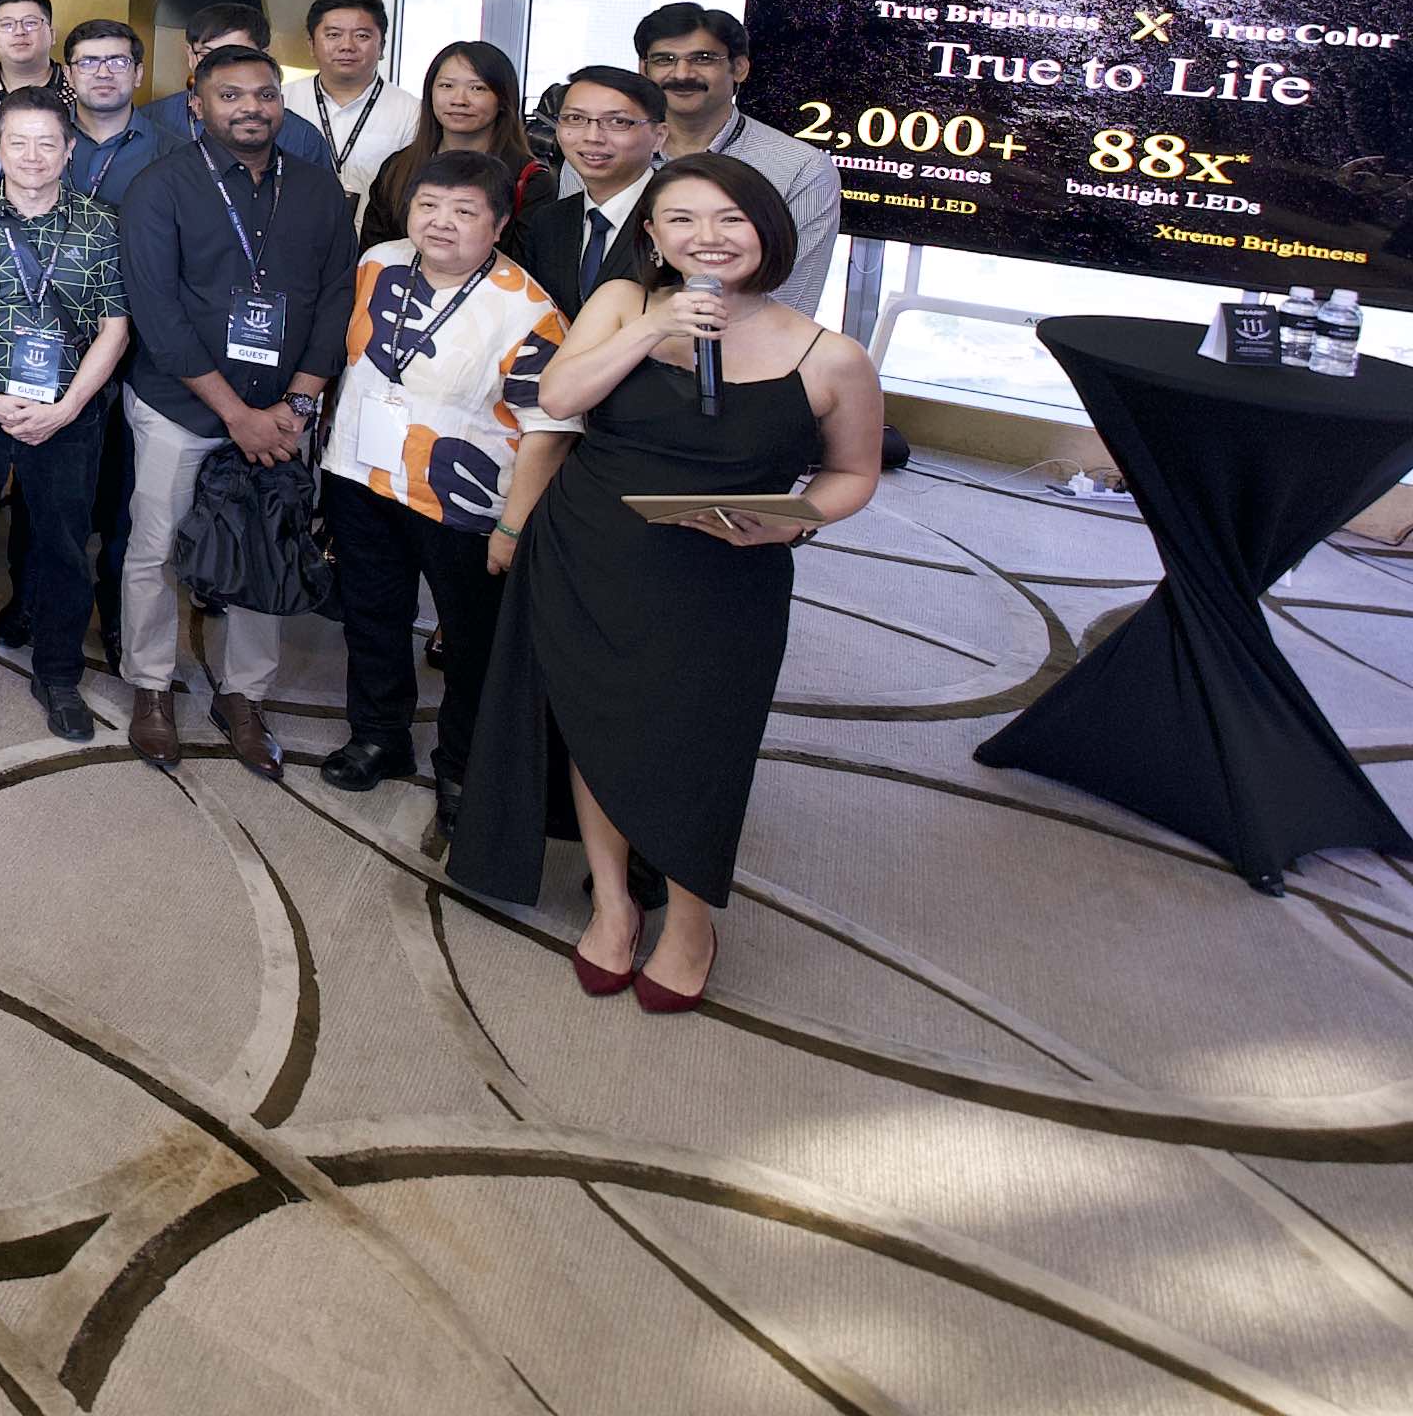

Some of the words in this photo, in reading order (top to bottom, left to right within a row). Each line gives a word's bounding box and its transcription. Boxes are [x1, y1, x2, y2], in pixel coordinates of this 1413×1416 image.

[875, 0, 939, 22] True
[946, 3, 1102, 31] Brightness
[1205, 18, 1286, 43] True
[1294, 24, 1401, 49] Color
[928, 41, 1062, 85] True
[1082, 57, 1145, 92] to
[1163, 57, 1313, 105] Life
[793, 101, 1028, 161] 2,000+
[819, 148, 915, 179] mming
[920, 163, 993, 185] zones
[884, 192, 926, 209] mini
[932, 197, 978, 215] LED
[1065, 178, 1180, 207] backlight
[1186, 191, 1262, 216] LEDs
[1153, 223, 1236, 248] Xtreme
[1242, 234, 1369, 266] Brightness
[238, 348, 269, 361] GUEST
